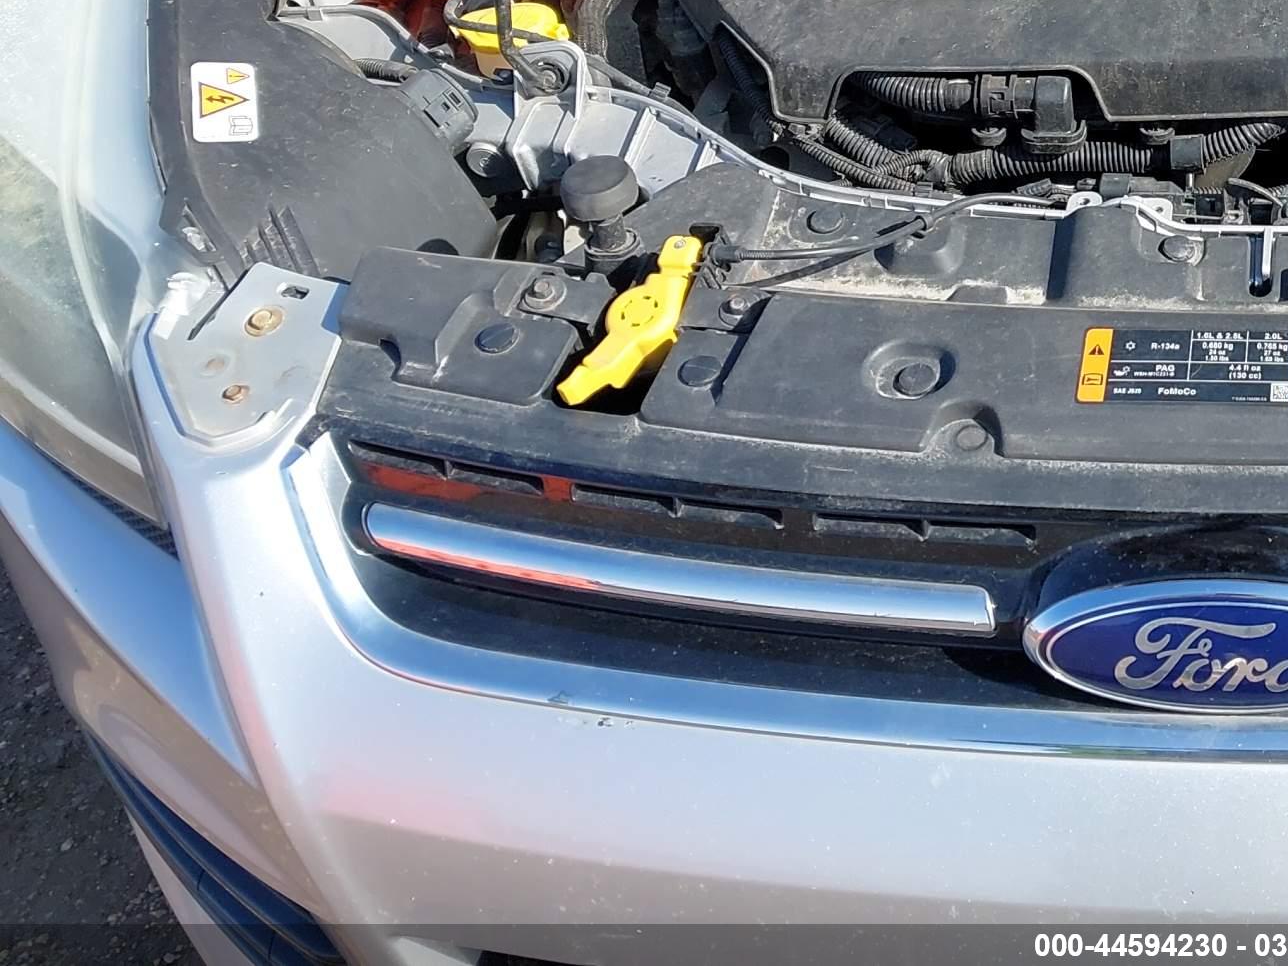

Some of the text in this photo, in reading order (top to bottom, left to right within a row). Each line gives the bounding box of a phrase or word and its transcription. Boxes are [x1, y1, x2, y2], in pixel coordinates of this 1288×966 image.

[1196, 331, 1215, 339] 1.6L
[1264, 332, 1283, 340] 2.0L
[1150, 342, 1180, 350] R-134a
[1224, 342, 1234, 351] kg
[1278, 343, 1288, 352] kg
[1155, 364, 1175, 372] PAG
[1228, 372, 1262, 380] (130 cc)
[1157, 387, 1197, 395] FoMoCo
